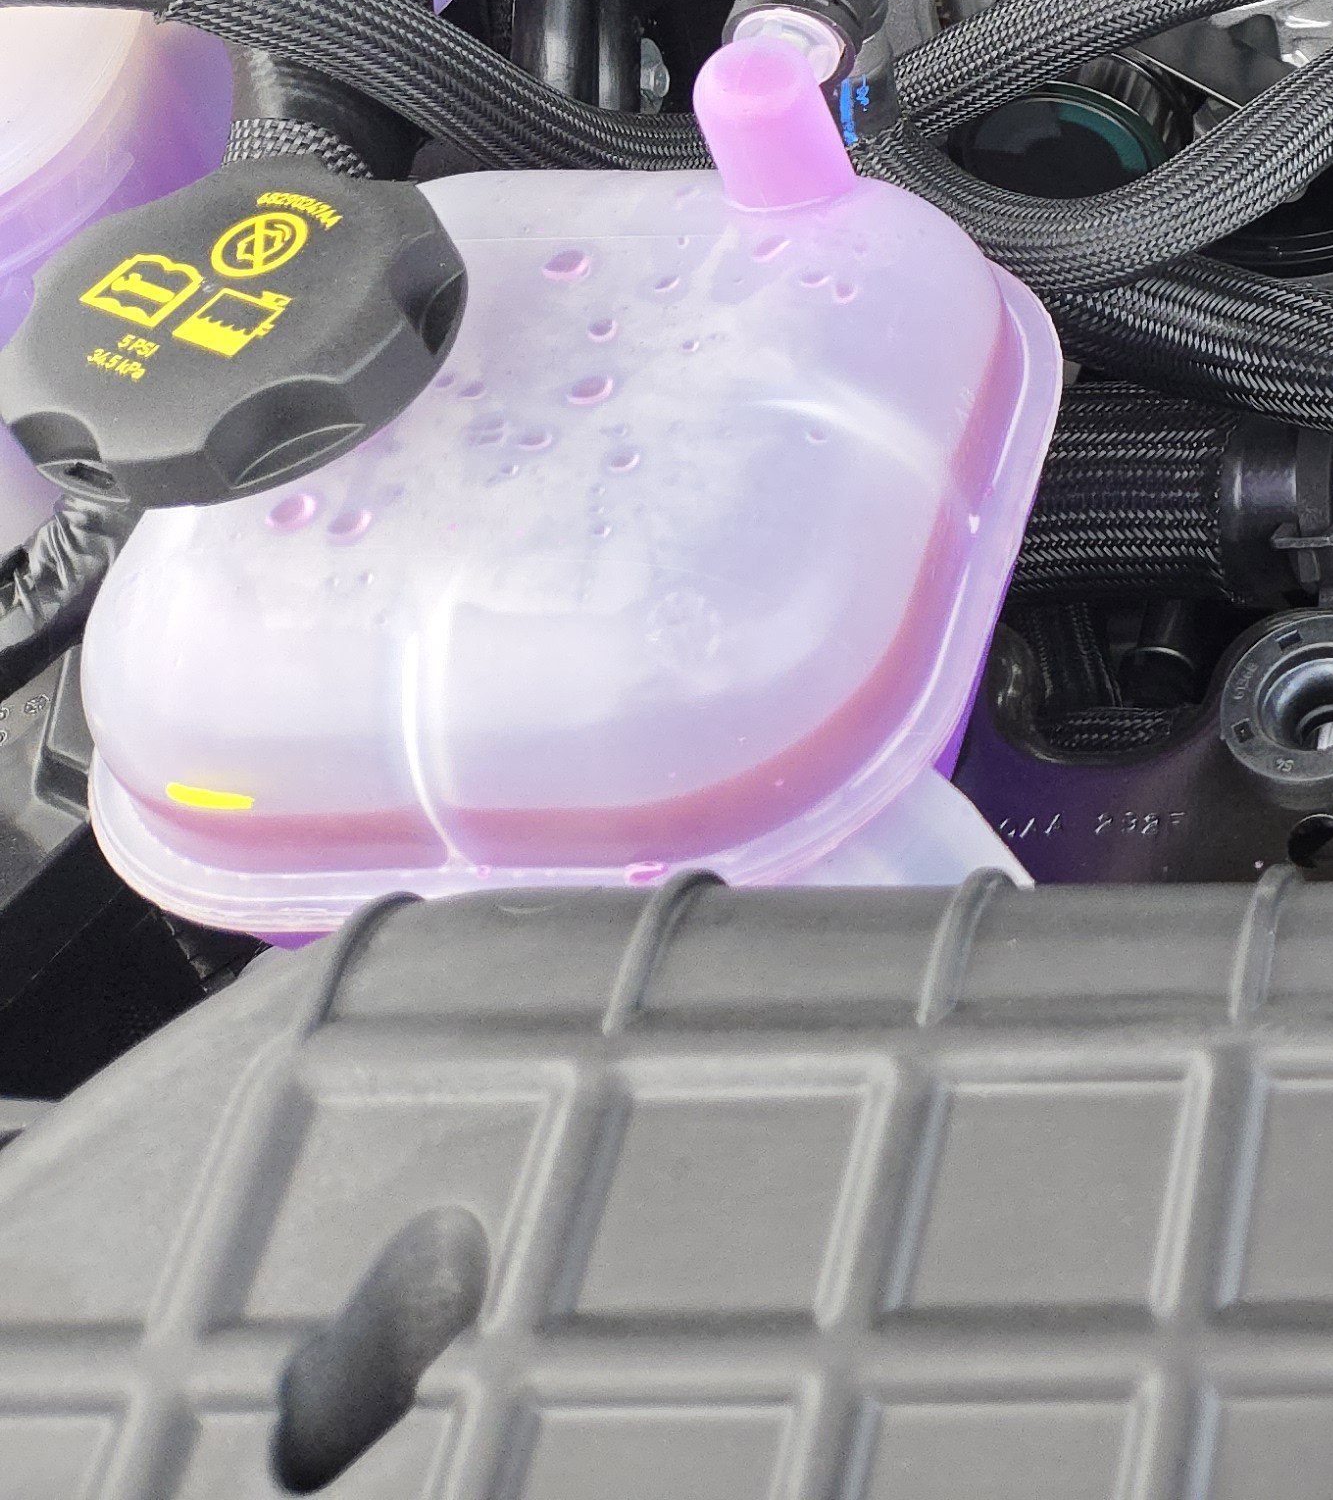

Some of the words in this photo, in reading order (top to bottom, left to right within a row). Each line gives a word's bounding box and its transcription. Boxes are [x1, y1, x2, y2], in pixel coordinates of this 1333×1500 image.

[117, 334, 136, 349] 5
[127, 338, 160, 358] PSI
[114, 358, 146, 381] kPa
